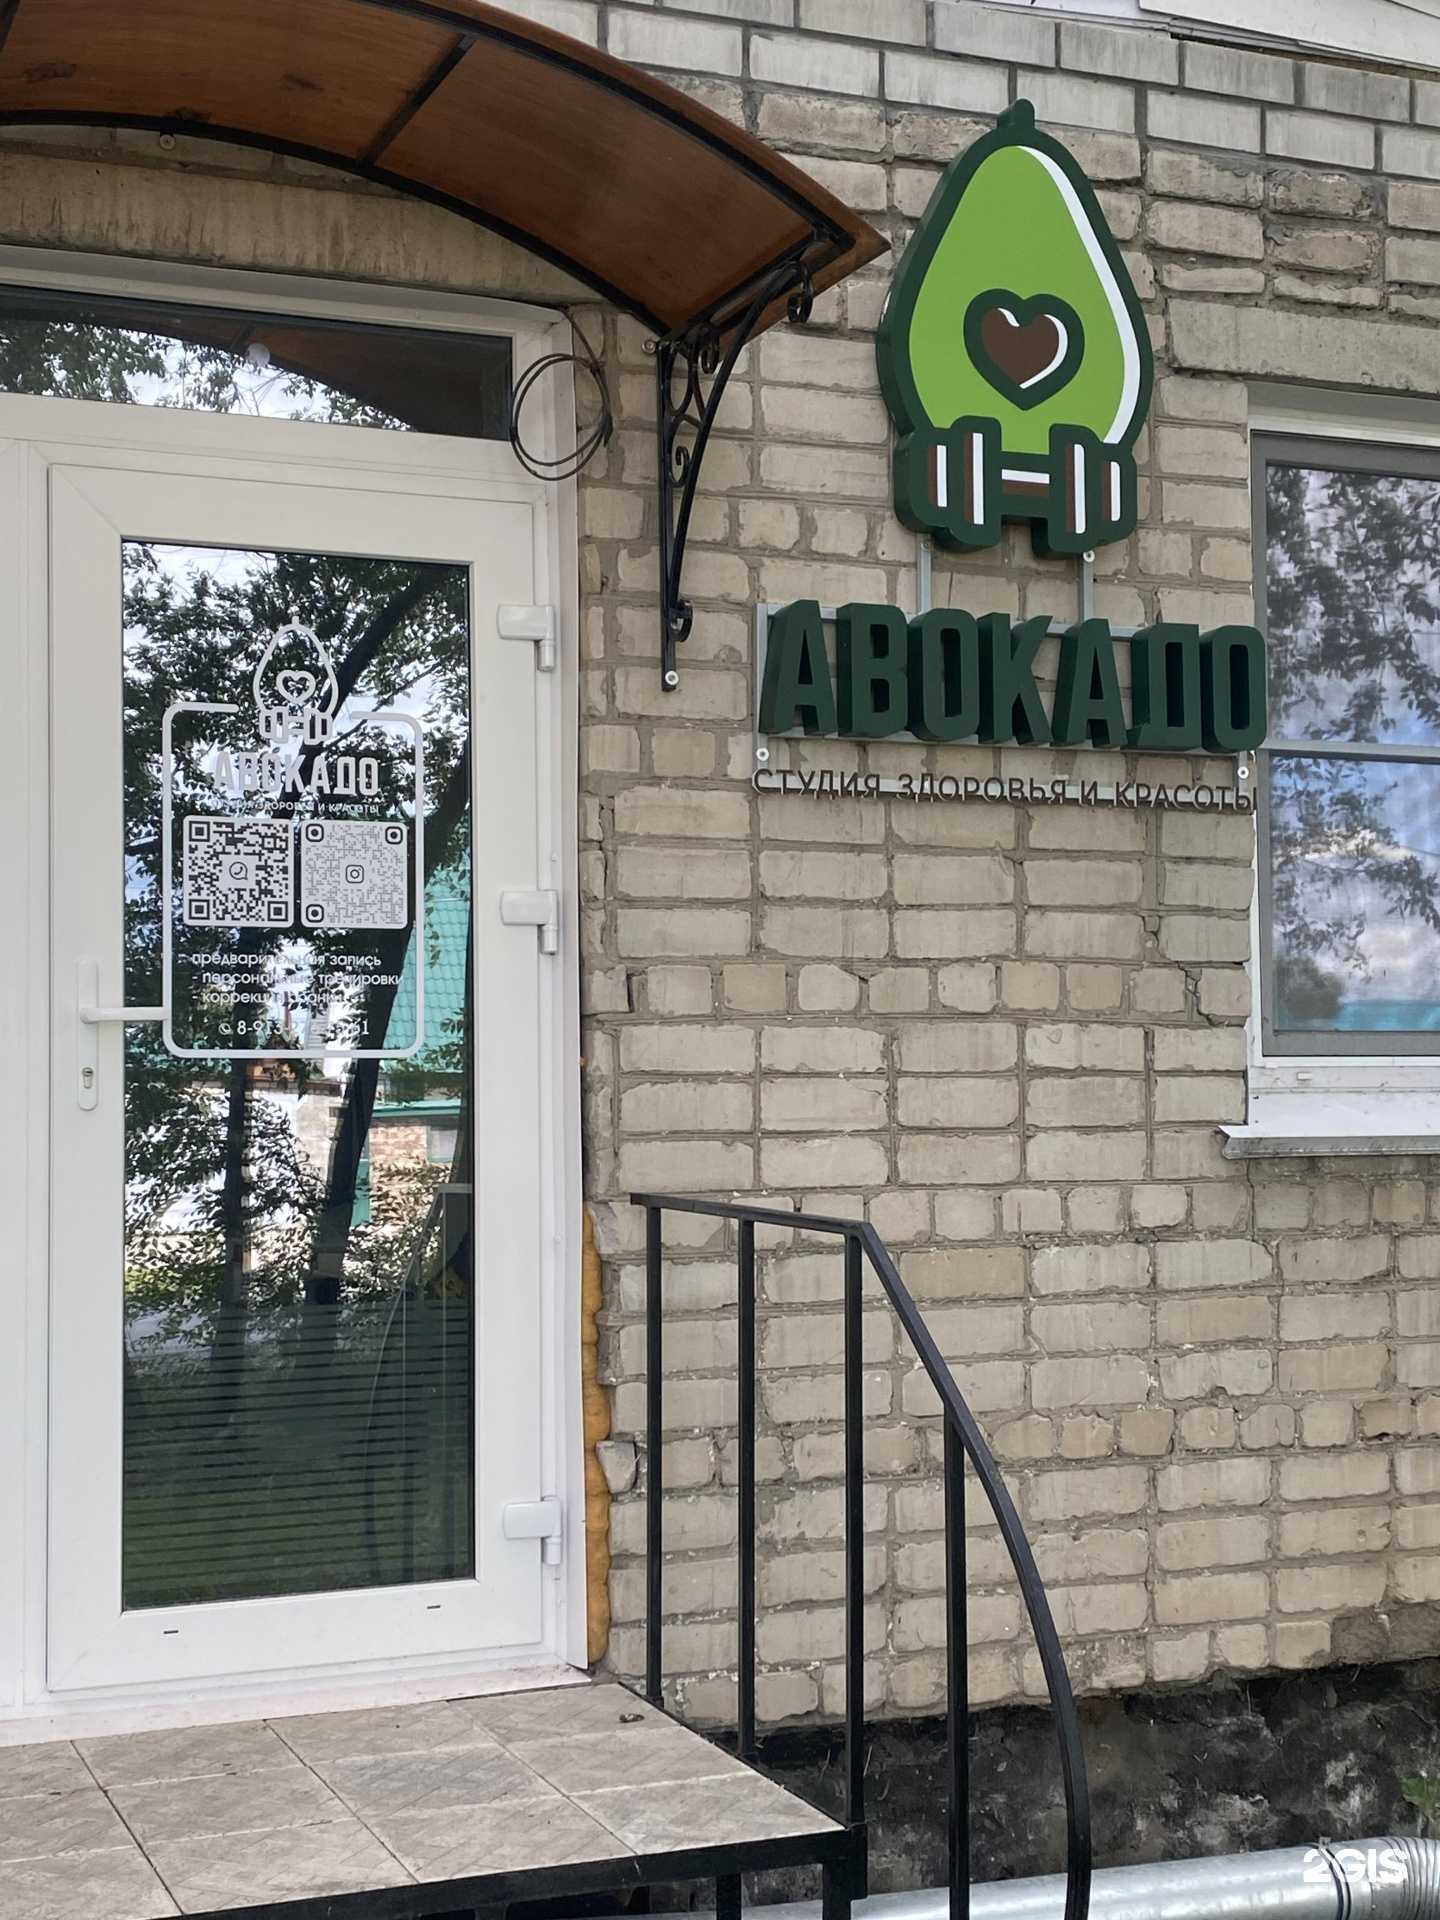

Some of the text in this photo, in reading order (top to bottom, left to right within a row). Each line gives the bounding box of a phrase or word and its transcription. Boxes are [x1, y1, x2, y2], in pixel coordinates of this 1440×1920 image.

[759, 599, 1267, 753] АВОКАДО
[213, 751, 380, 797] АВОКАДО
[752, 768, 1258, 816] СТУДИЯ ЗДОРОВЬЯ И КРАСОТЫ
[191, 953, 382, 969] предваритая запись
[202, 992, 286, 1007] коррекц
